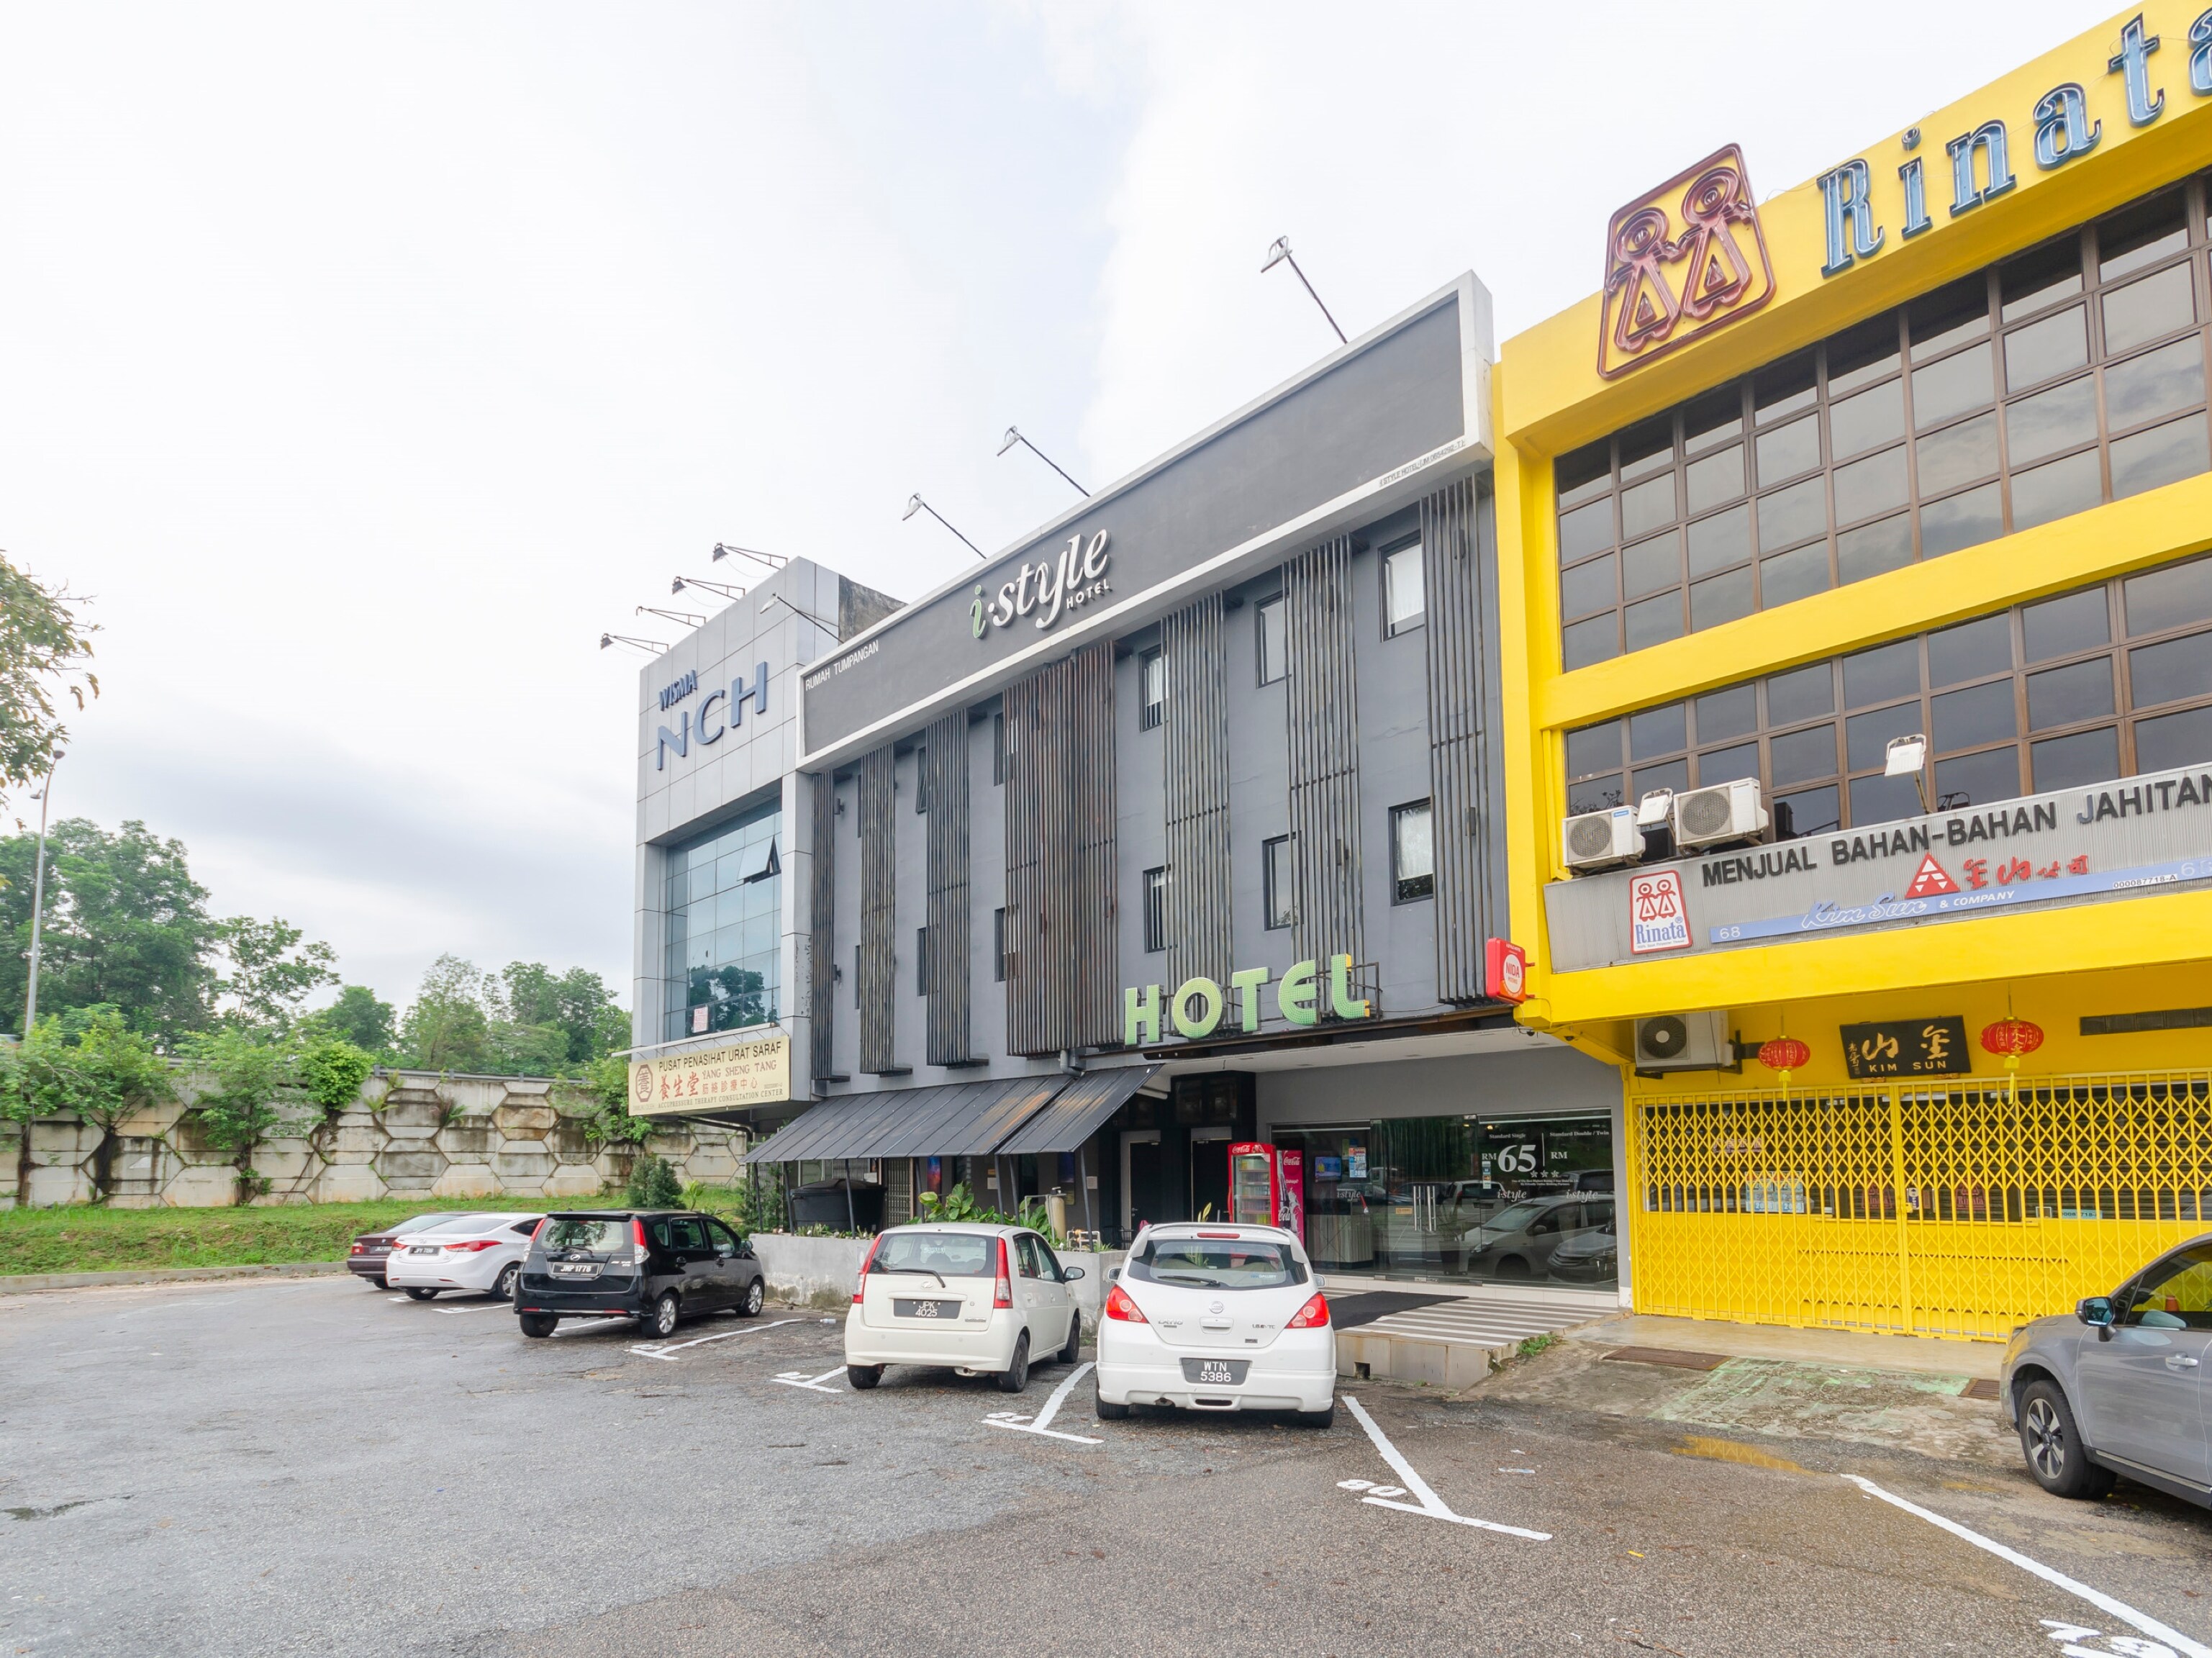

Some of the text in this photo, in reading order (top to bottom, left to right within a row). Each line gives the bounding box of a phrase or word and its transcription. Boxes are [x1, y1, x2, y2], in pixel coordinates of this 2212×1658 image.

[1066, 578, 1112, 611] HOTEL
[805, 640, 879, 692] RUMAH TUMPANGAN
[658, 669, 698, 712] WISMA
[656, 661, 768, 771] NCH
[1702, 846, 1818, 888] MENJUAL
[1831, 801, 2057, 866] BAHAN-BAHAN
[2113, 874, 2177, 889] 000087718-A
[1801, 890, 2016, 929] Kim Sun & COMPANY
[1635, 921, 1687, 944] Rinata
[1720, 927, 1741, 940] 68
[1125, 953, 1370, 1046] HOTEL
[658, 1041, 781, 1072] PUSAT PENASIHAT URAT SARAF
[1869, 1061, 1946, 1073] KIM SUN
[702, 1060, 777, 1080] YANG SHENG TANG
[760, 1087, 784, 1098] CENTER
[1497, 1144, 1537, 1172] 65
[915, 1308, 938, 1318] 4025
[1200, 1372, 1232, 1382] 5386
[1204, 1361, 1227, 1372] WTN
